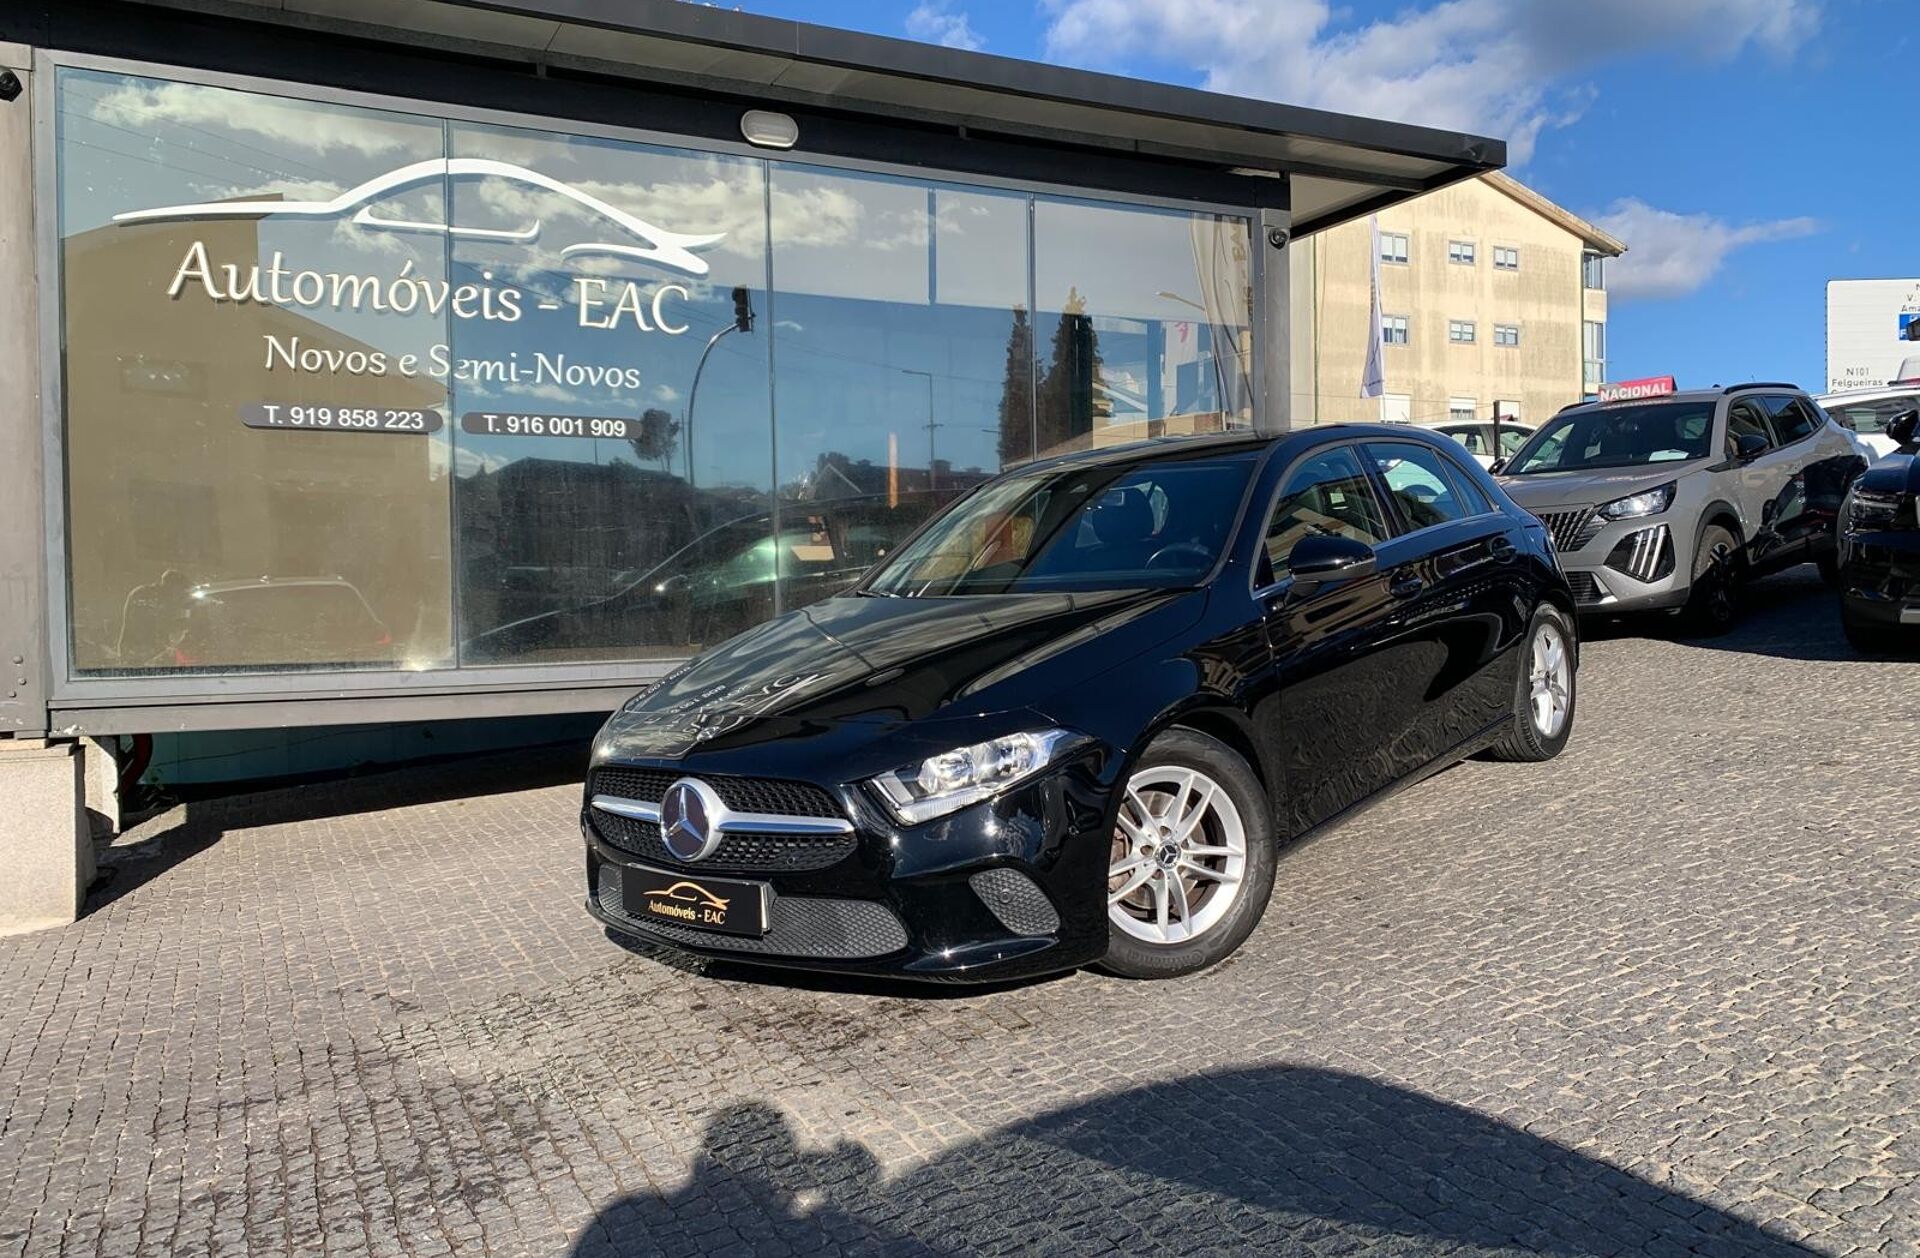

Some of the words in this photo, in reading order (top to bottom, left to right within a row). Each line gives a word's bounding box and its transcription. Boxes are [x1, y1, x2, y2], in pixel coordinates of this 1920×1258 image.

[168, 241, 522, 322] Automóveis
[574, 278, 690, 335] EAC
[263, 335, 386, 374] Novos
[399, 353, 418, 375] e
[429, 343, 641, 389] Semi-Novos
[1600, 382, 1669, 402] NACIONAL
[1832, 378, 1883, 388] Felgueiras
[263, 405, 283, 424] T.
[290, 407, 331, 425] 919
[338, 409, 378, 427] 858
[384, 411, 424, 429] 223
[483, 414, 500, 433] T.
[507, 416, 543, 433] 916
[549, 417, 583, 435] 001
[590, 419, 626, 437] 909
[648, 900, 696, 920] Automóveis
[704, 909, 726, 925] EAC
